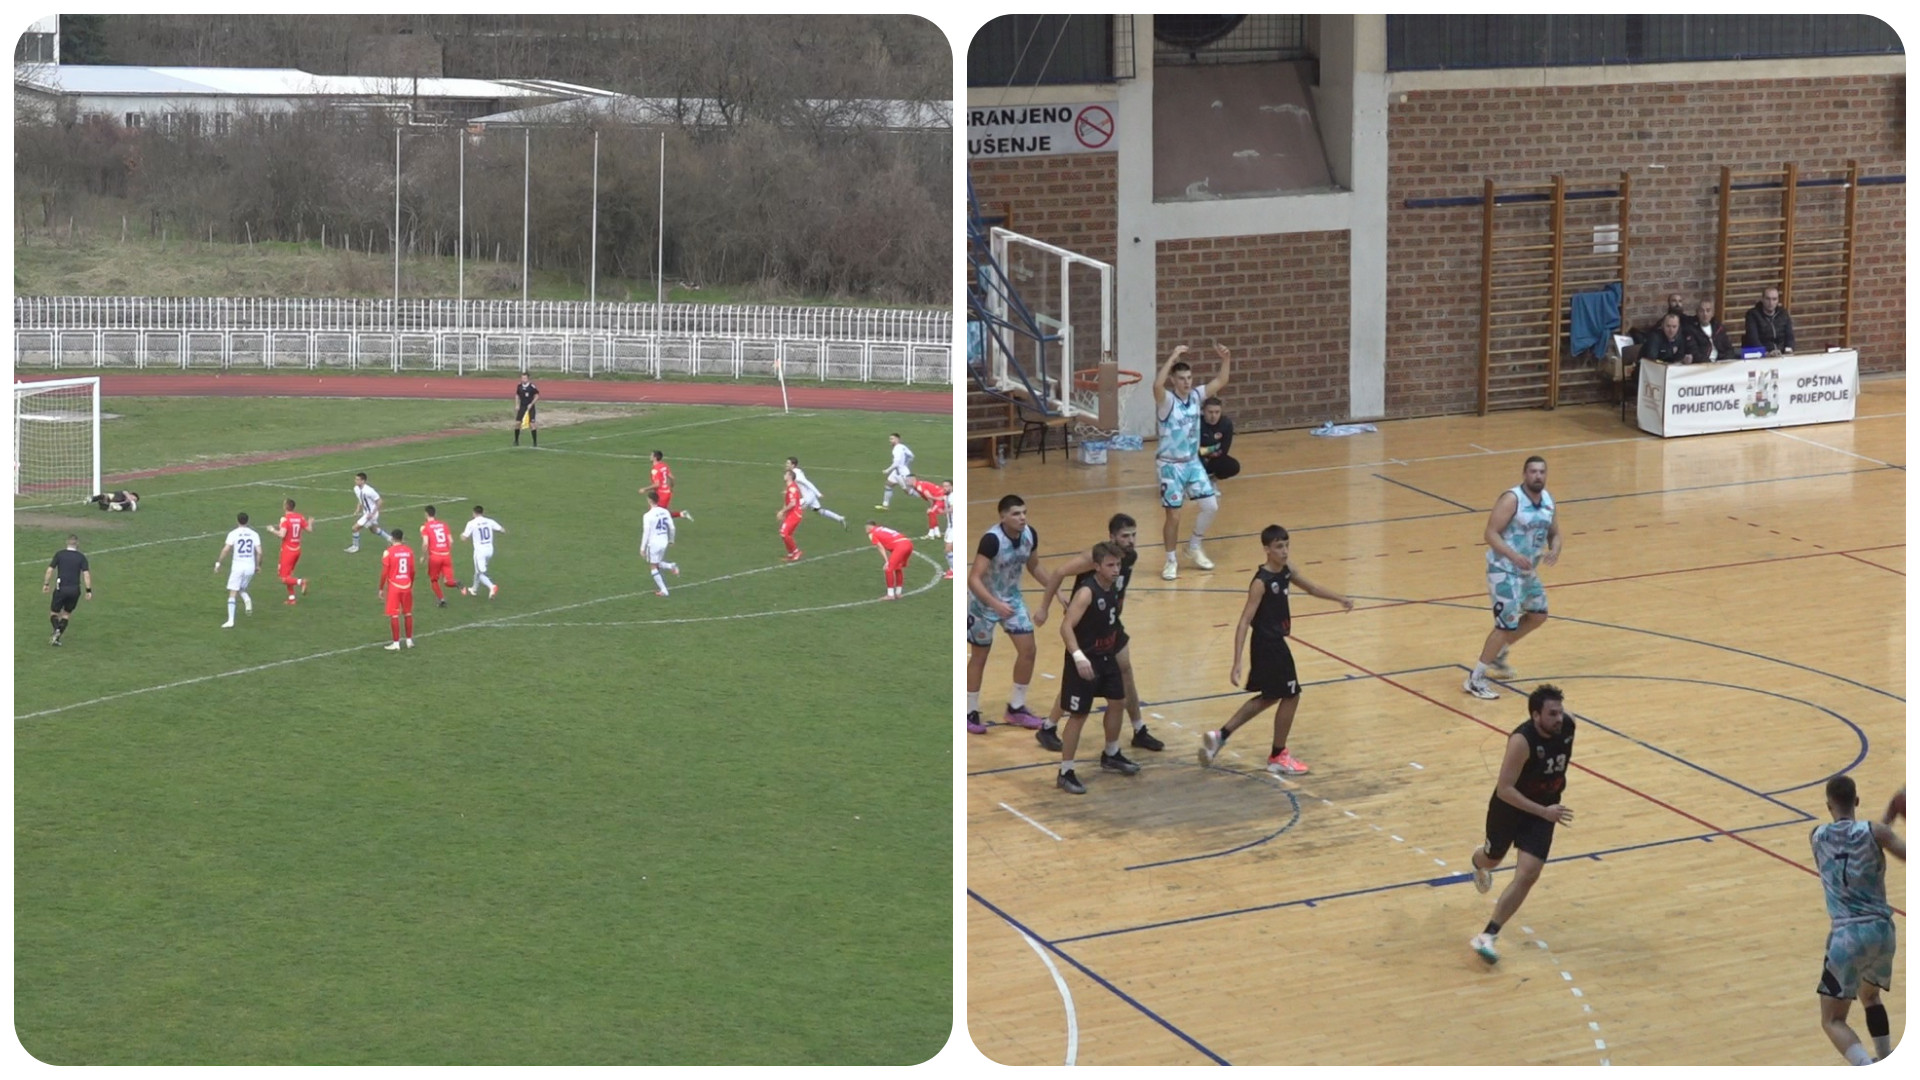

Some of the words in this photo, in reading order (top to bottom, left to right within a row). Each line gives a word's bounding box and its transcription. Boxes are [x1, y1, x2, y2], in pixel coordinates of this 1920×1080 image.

[967, 107, 1072, 127] RANJENO
[1797, 374, 1843, 388] OPŠTINA
[1678, 383, 1735, 398] ОПШТИНА
[1790, 389, 1849, 404] PRIJEPOLJE
[1672, 399, 1740, 415] ПРИЈЕПОЉЕ
[655, 517, 669, 530] 45
[433, 528, 446, 543] 15
[478, 527, 490, 541] 10
[237, 538, 253, 553] 23
[398, 557, 408, 573] 8
[1108, 606, 1116, 625] 5
[1287, 679, 1297, 694] 7
[1069, 695, 1081, 711] 5
[1543, 753, 1567, 774] 13
[1834, 852, 1849, 887] 7
